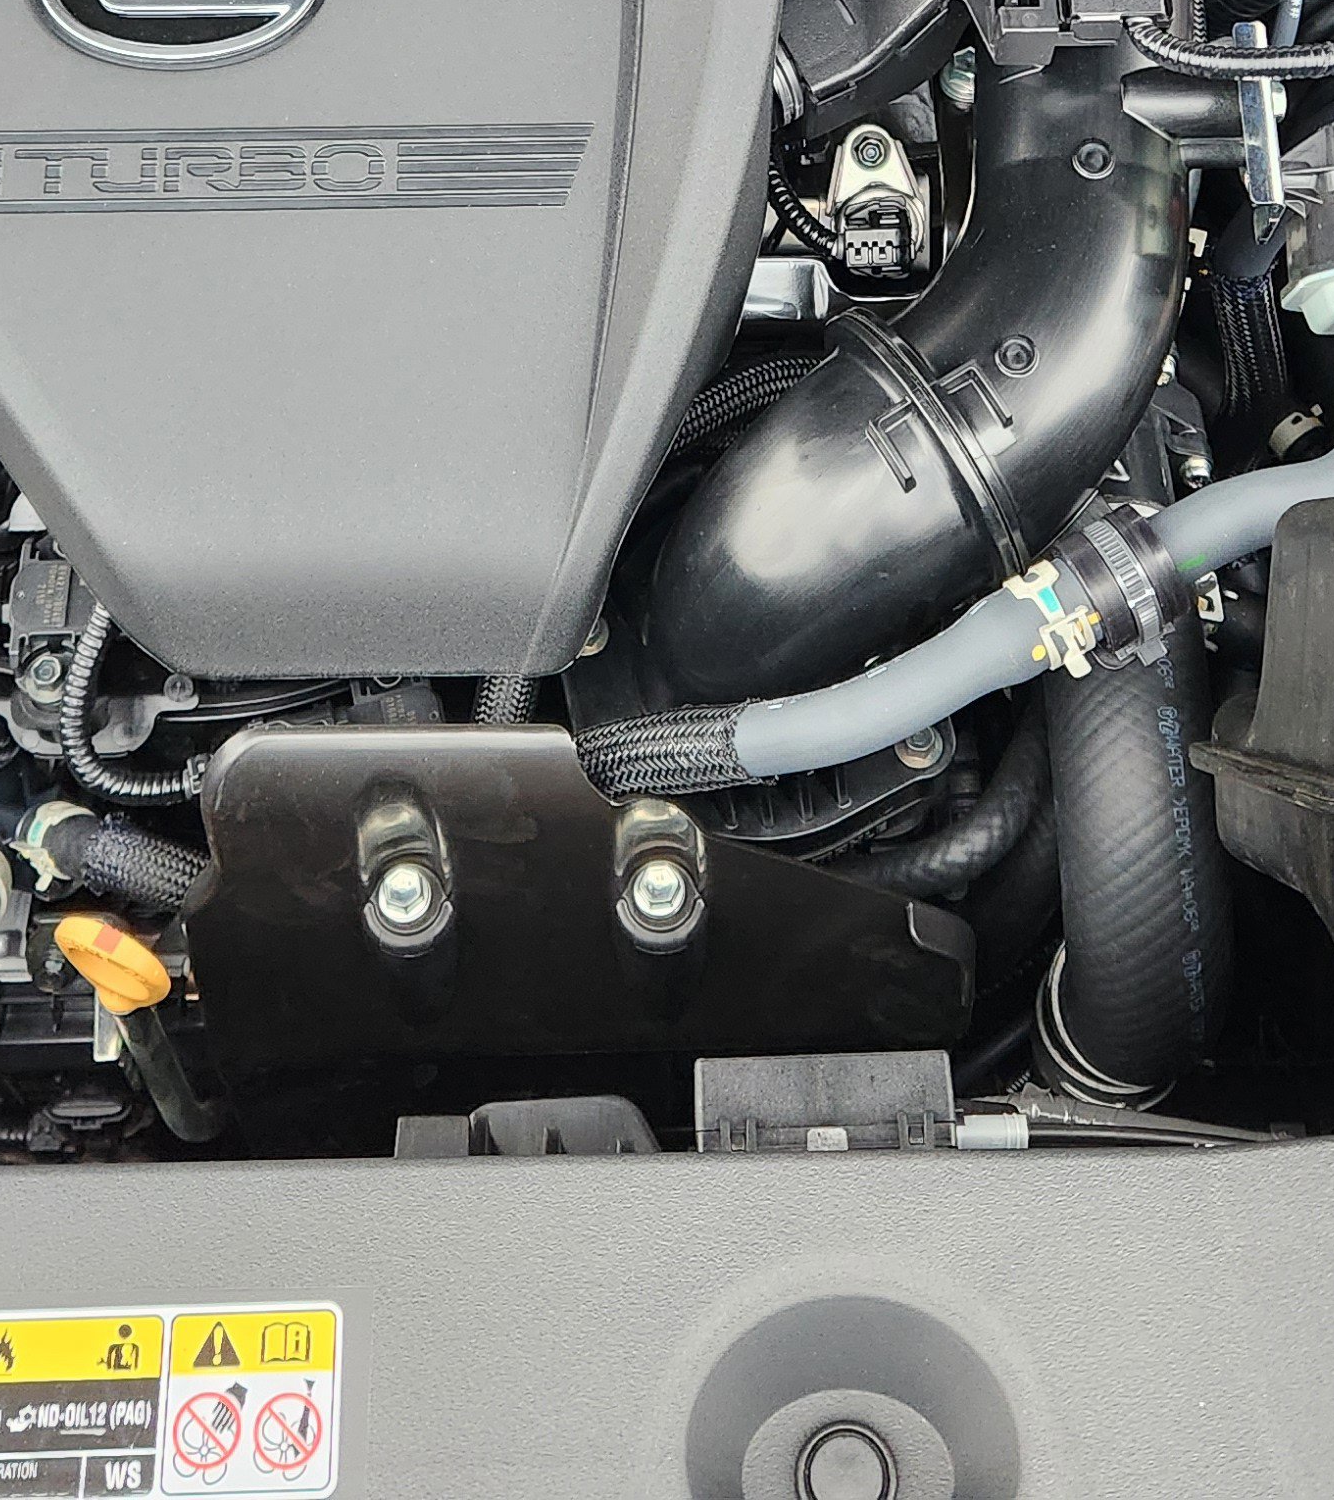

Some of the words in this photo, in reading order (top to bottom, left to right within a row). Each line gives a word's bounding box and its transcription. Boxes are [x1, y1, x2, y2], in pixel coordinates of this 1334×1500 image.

[13, 143, 385, 195] TURBO
[109, 1399, 151, 1429] (PAG)
[105, 1461, 142, 1489] WS
